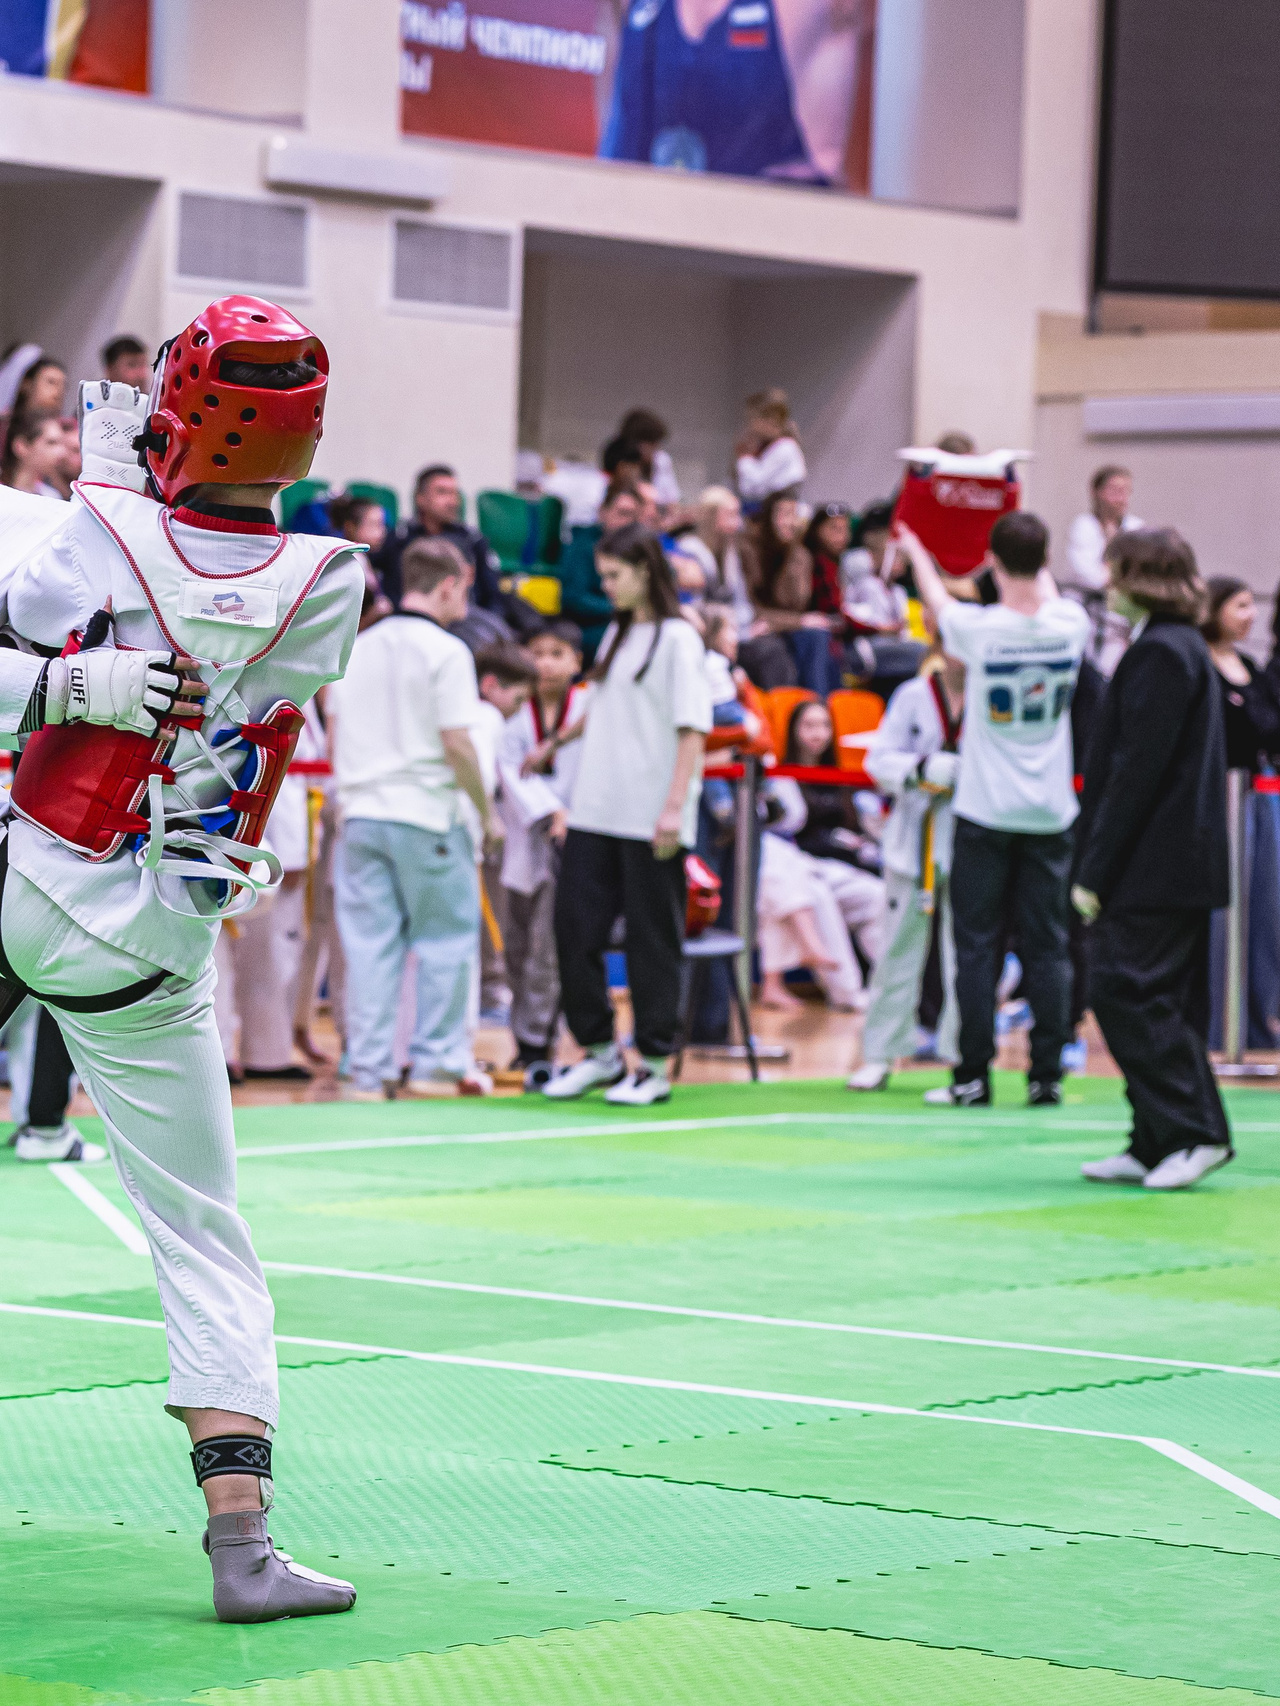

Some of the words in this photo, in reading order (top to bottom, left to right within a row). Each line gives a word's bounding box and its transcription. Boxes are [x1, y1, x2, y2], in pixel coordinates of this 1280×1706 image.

[400, 0, 466, 50] НЫЙ
[471, 14, 606, 74] ЧЕМПИОН
[200, 608, 216, 617] PROF
[71, 667, 86, 705] CLIFF
